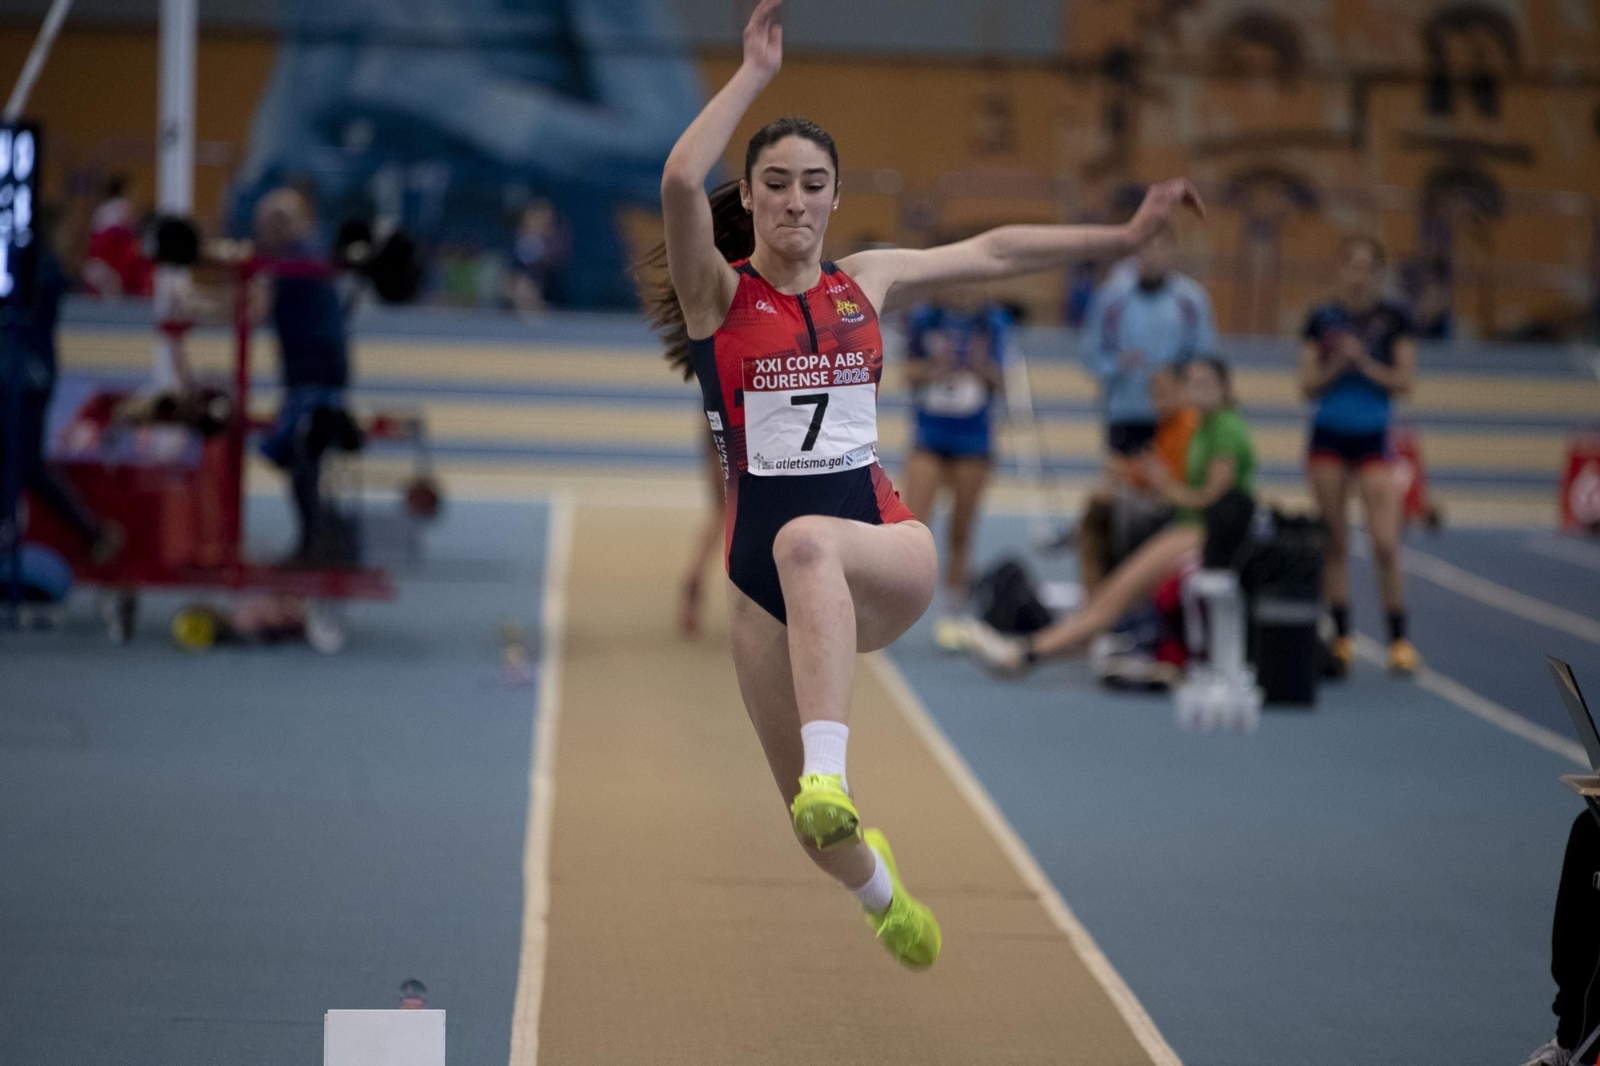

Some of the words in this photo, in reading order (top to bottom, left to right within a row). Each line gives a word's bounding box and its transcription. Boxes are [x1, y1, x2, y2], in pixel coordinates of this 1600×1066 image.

[755, 358, 781, 373] XXI
[786, 354, 830, 369] COPA
[834, 351, 864, 367] ABS
[753, 371, 829, 389] OURENSE
[833, 367, 869, 384] 2026
[790, 393, 829, 452] 7
[717, 434, 730, 480] XUNTA
[775, 456, 844, 471] atletismo.gal
